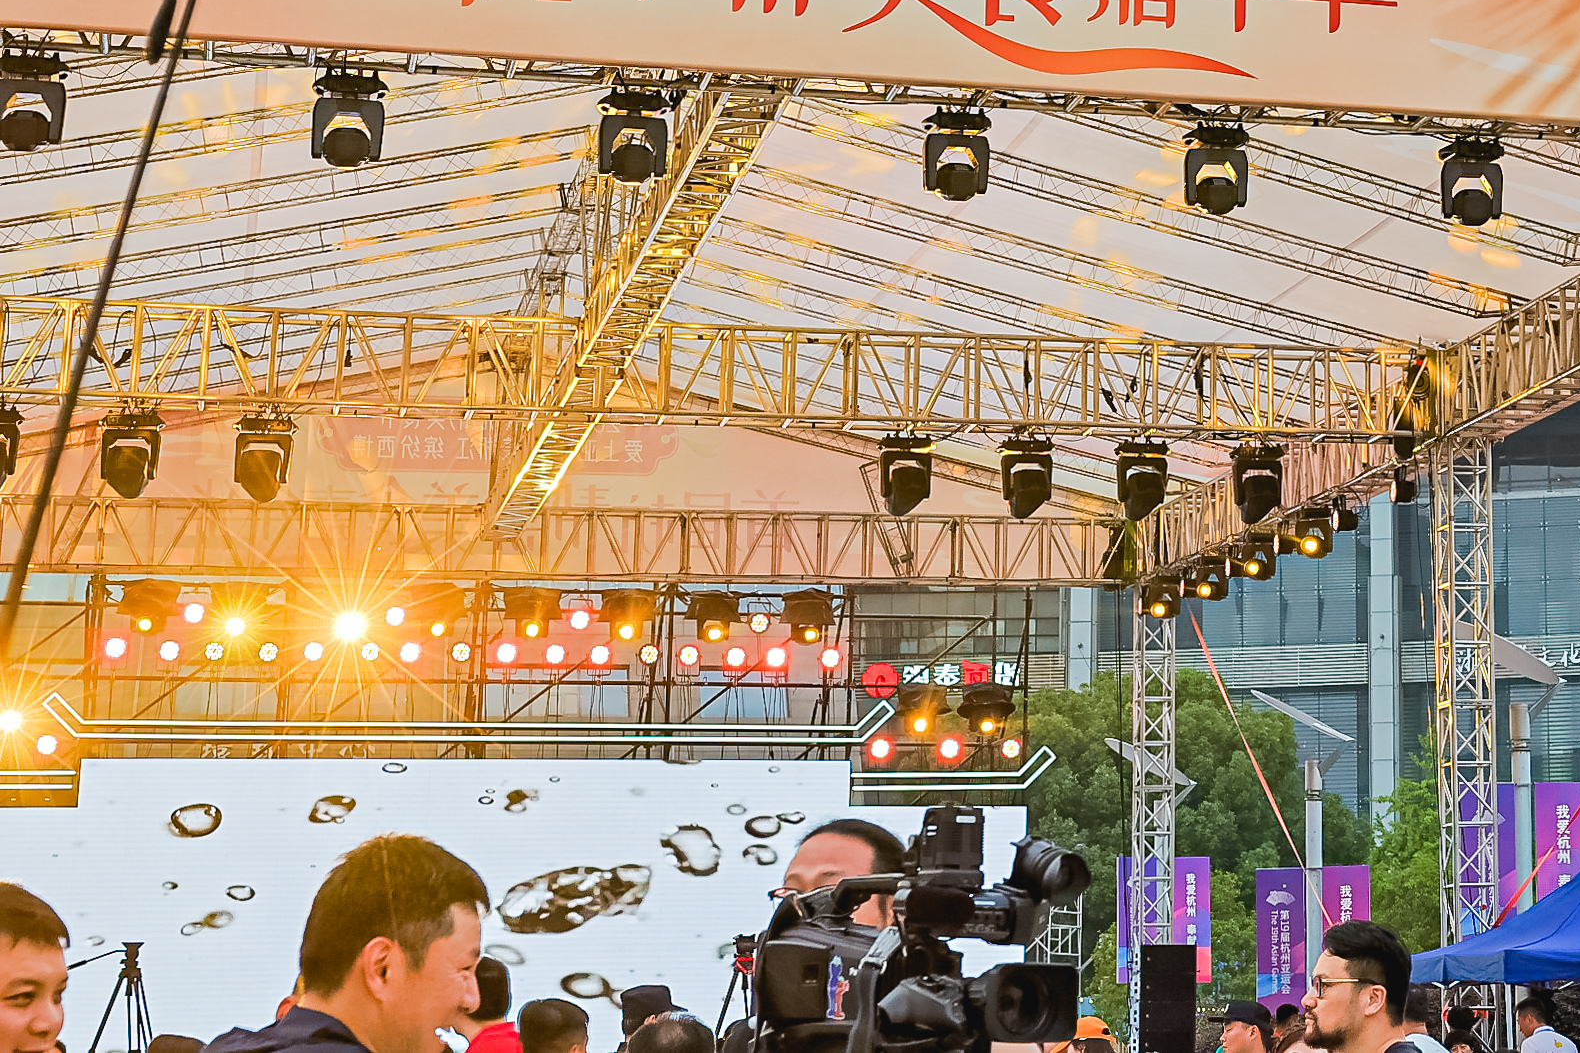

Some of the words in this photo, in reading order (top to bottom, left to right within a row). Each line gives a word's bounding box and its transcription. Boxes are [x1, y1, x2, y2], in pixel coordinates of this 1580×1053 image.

[1556, 804, 1571, 865] 我爱杭州
[1185, 873, 1197, 917] 我爱杭州
[1270, 910, 1279, 927] The
[1271, 928, 1279, 942] 19th
[1271, 943, 1279, 965] Asian
[1271, 966, 1280, 994] Games
